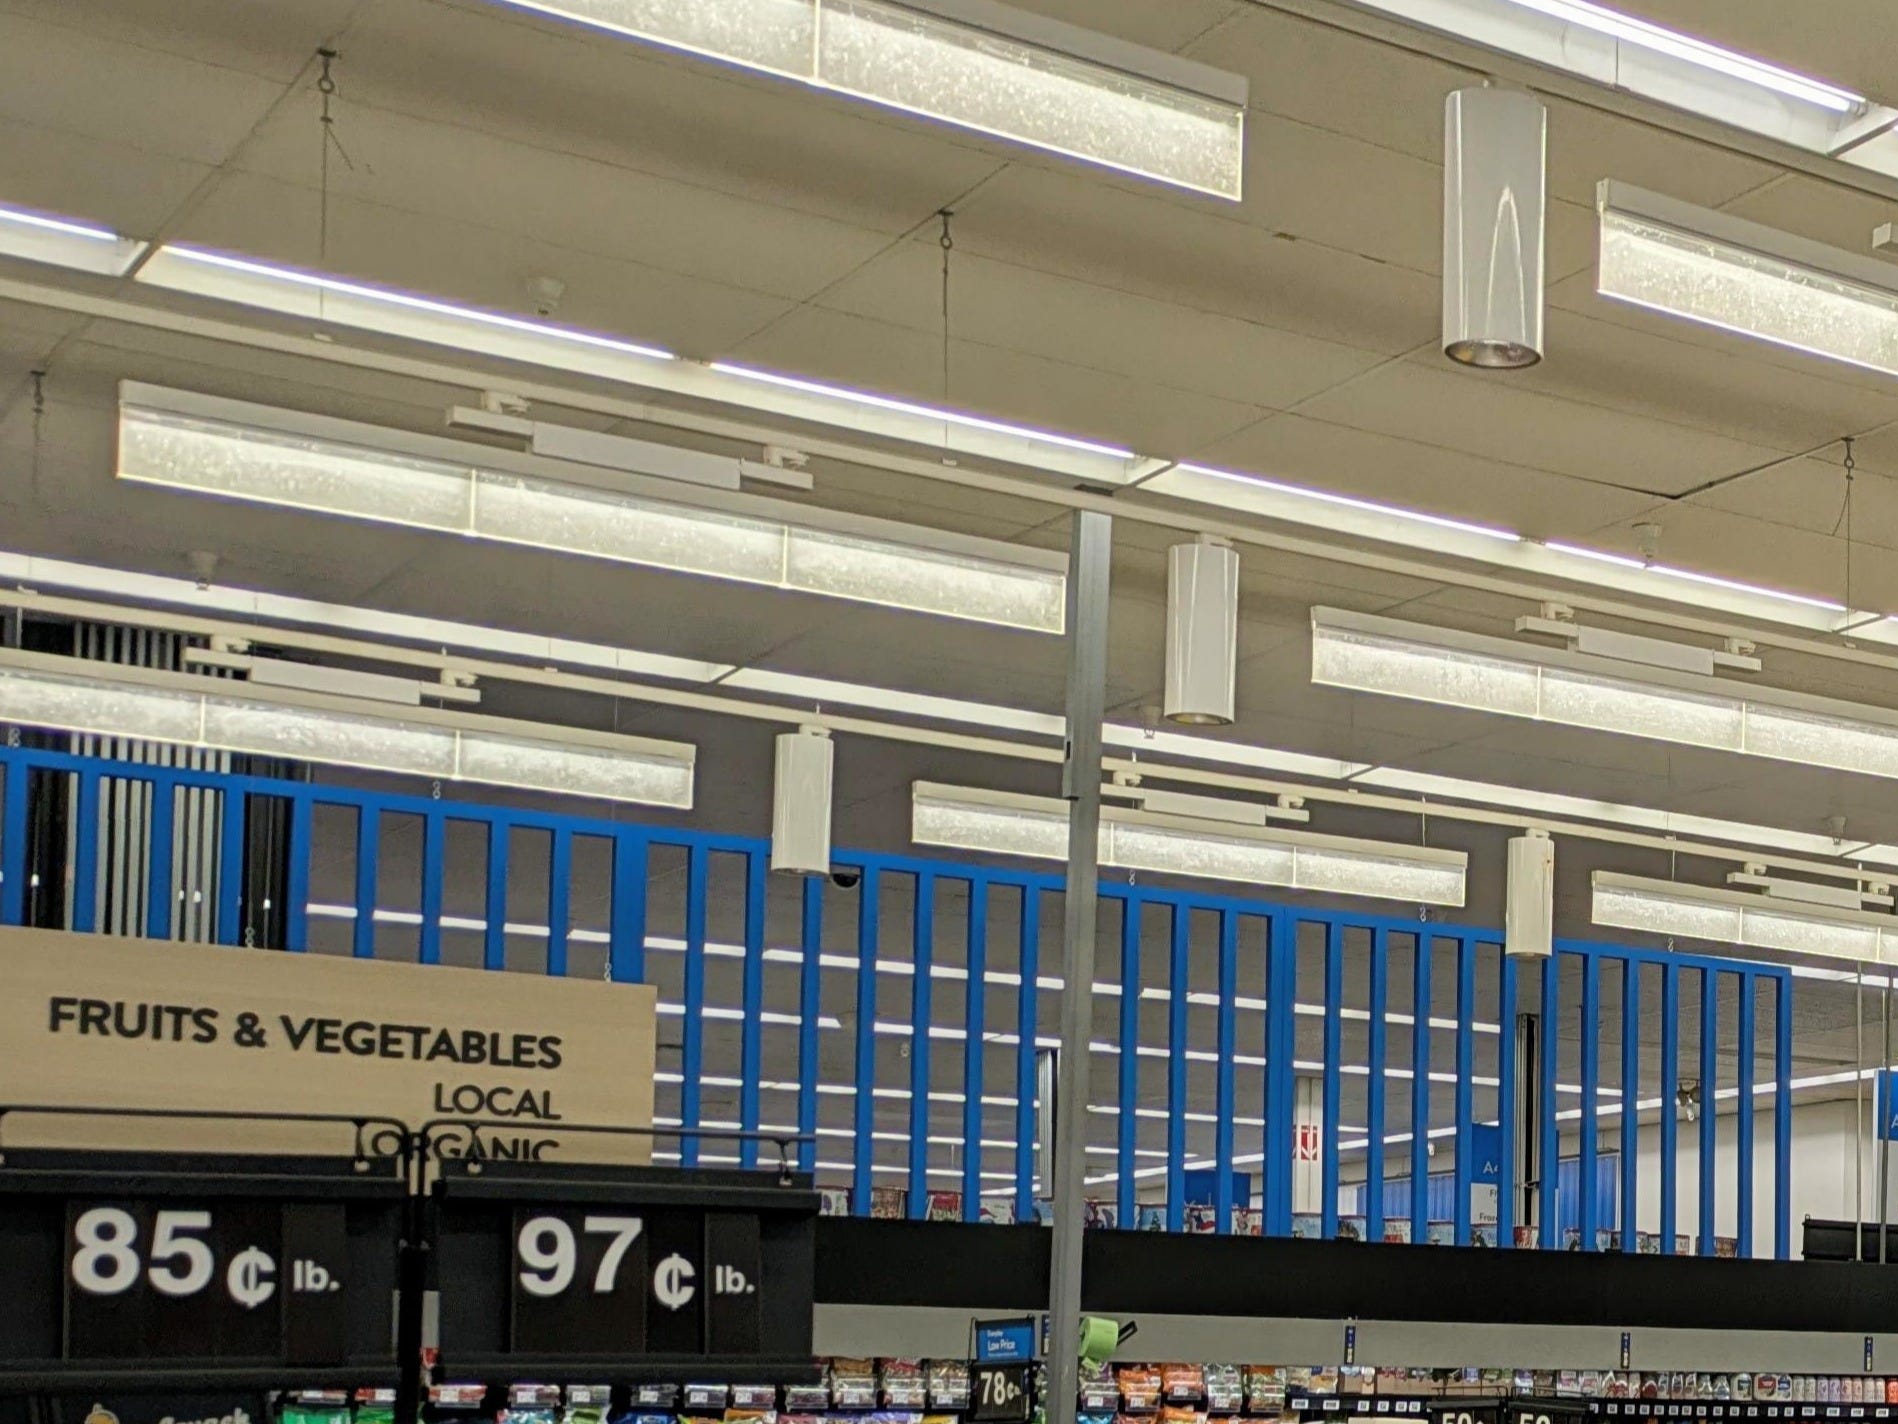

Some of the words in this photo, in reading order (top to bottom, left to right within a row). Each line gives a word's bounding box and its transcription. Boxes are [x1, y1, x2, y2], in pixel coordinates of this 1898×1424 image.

[49, 997, 219, 1044] FRUITS
[234, 1011, 268, 1050] &
[280, 1014, 562, 1070] VEGETABLES
[434, 1082, 562, 1121] LOCAL
[71, 1206, 277, 1310] 85¢
[293, 1259, 341, 1293] lb.
[517, 1215, 697, 1312] 97¢
[714, 1264, 755, 1294] lb.
